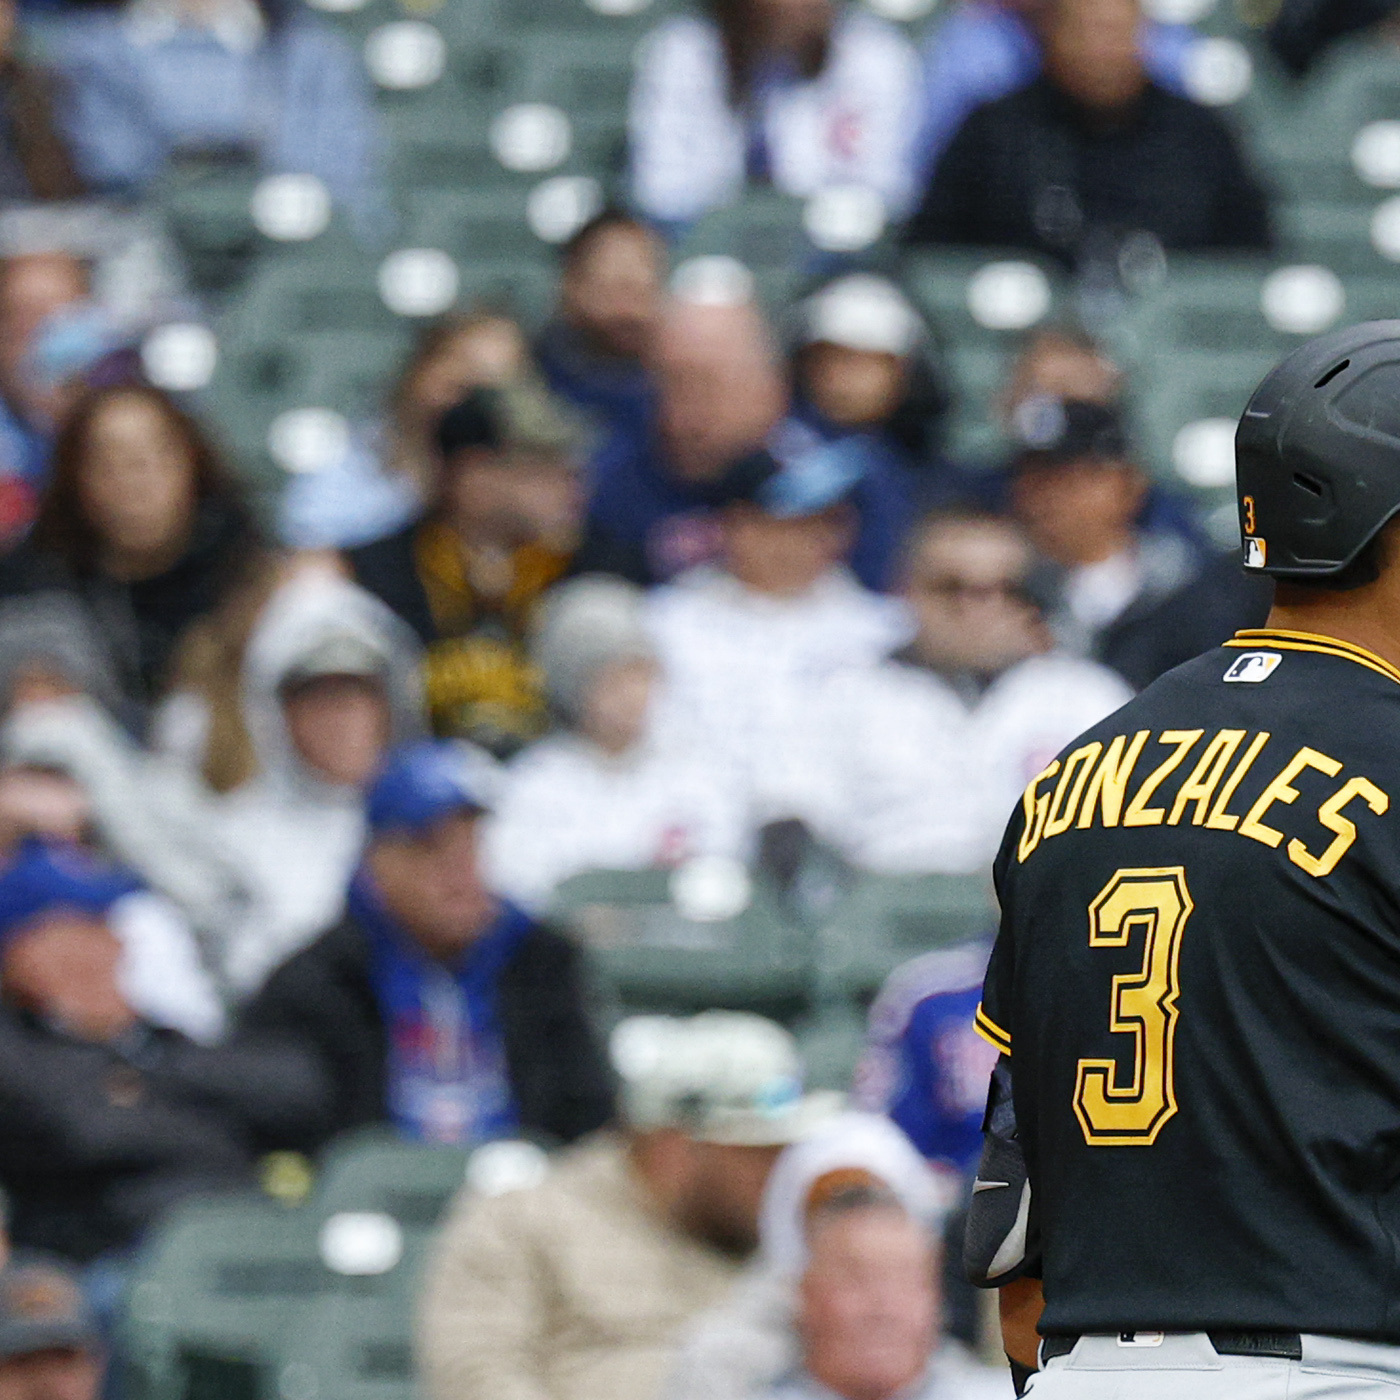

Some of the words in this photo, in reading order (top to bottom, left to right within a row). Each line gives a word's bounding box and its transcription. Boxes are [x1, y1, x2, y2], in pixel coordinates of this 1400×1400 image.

[1244, 495, 1256, 534] 3
[1016, 728, 1389, 878] GONZALES
[1072, 866, 1194, 1146] 3
